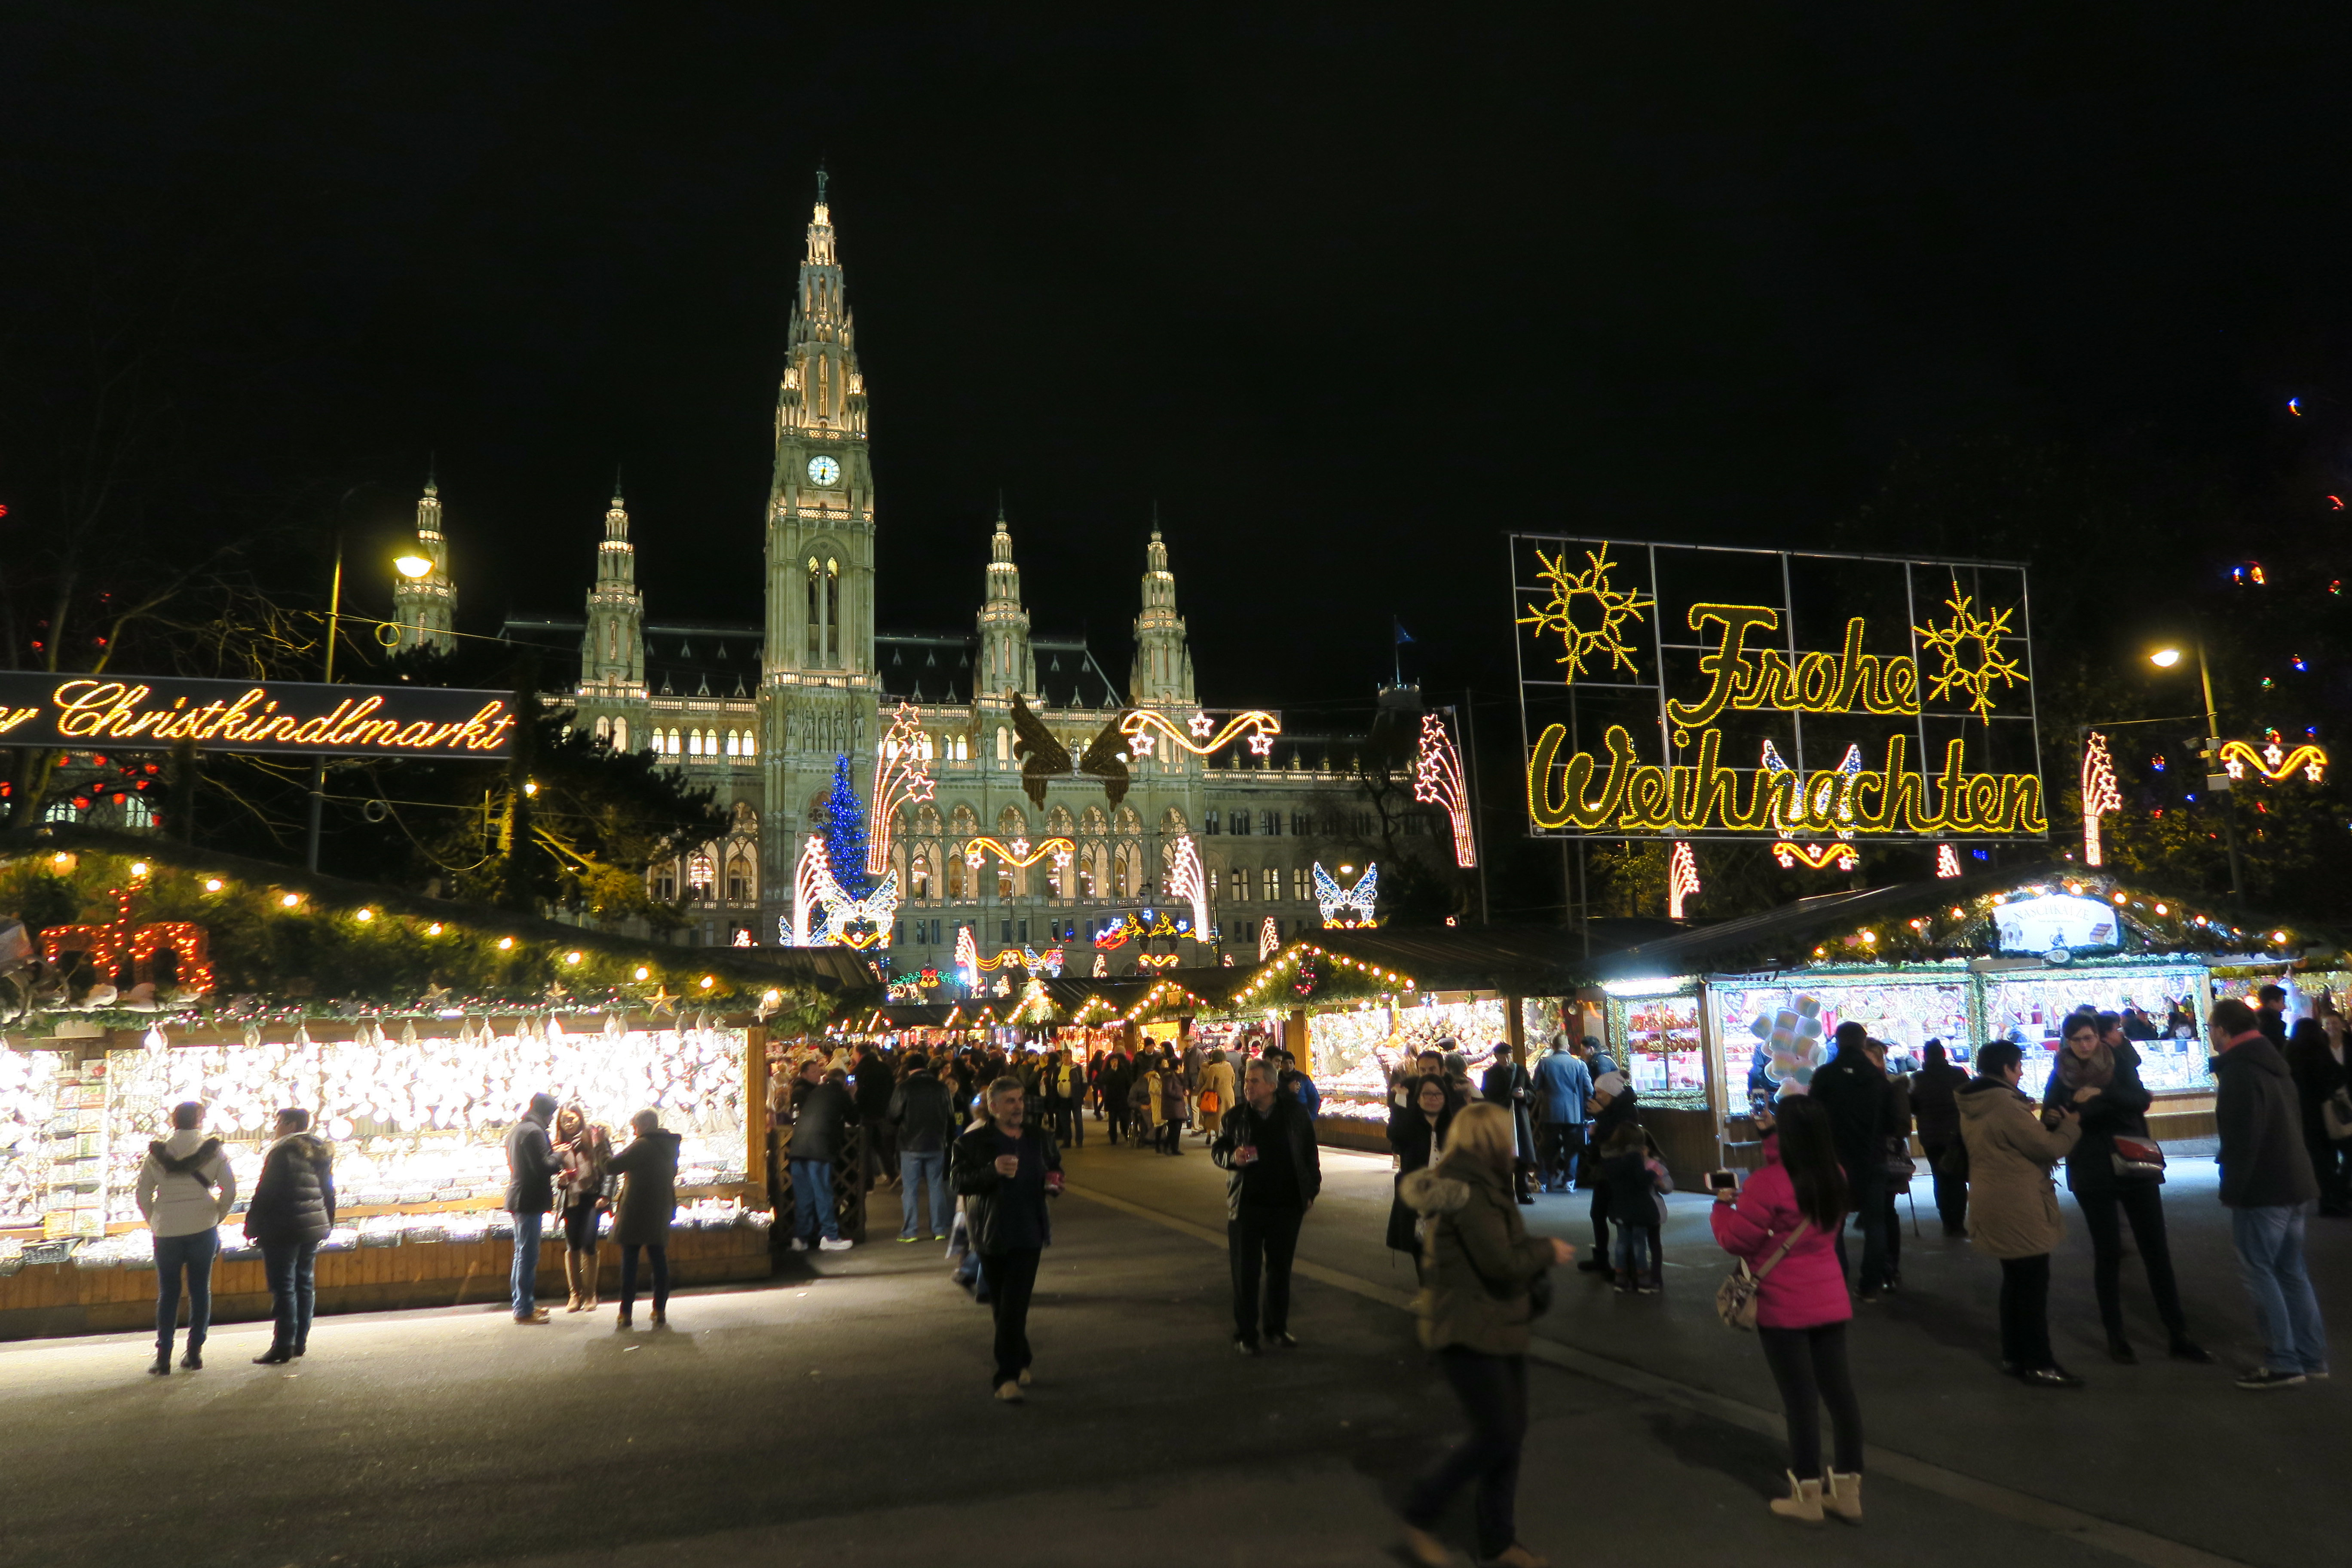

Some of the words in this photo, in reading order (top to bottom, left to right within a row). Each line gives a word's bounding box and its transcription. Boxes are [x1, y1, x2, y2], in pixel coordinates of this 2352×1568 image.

[1666, 603, 1921, 728] Frohe
[52, 679, 517, 750] Christkindlmarkt
[1528, 723, 2049, 832] Weihnachten
[2013, 904, 2089, 922] NASCHKATZE
